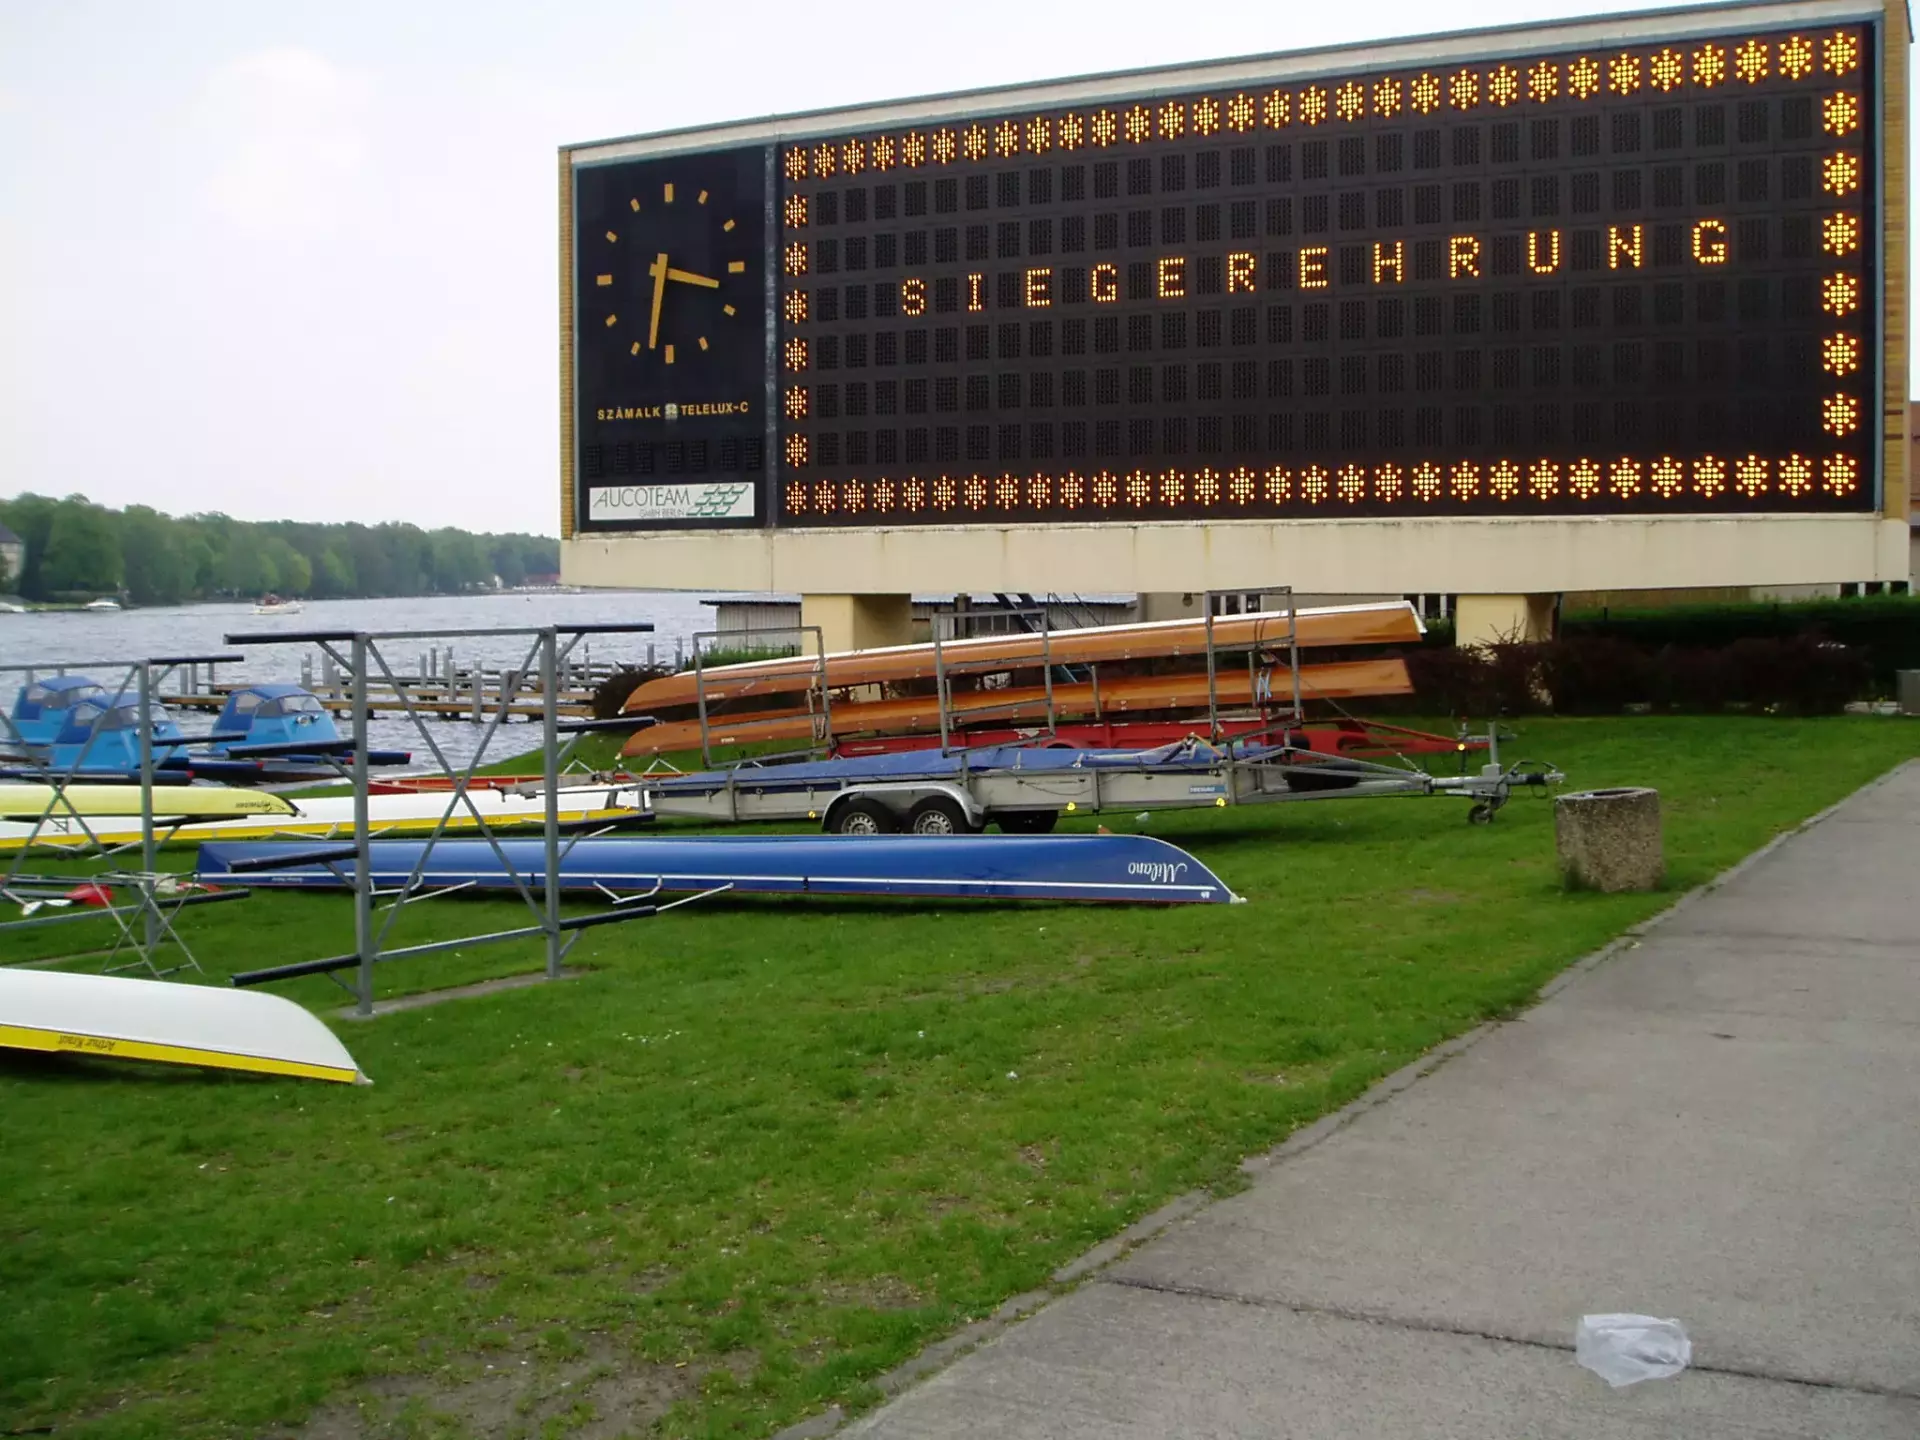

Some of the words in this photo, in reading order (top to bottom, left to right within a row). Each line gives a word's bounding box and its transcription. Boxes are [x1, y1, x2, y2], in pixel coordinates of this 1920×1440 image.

[680, 401, 749, 416] TELELUX-C
[593, 487, 691, 507] AUCOTEAM
[1127, 863, 1188, 883] Milano
